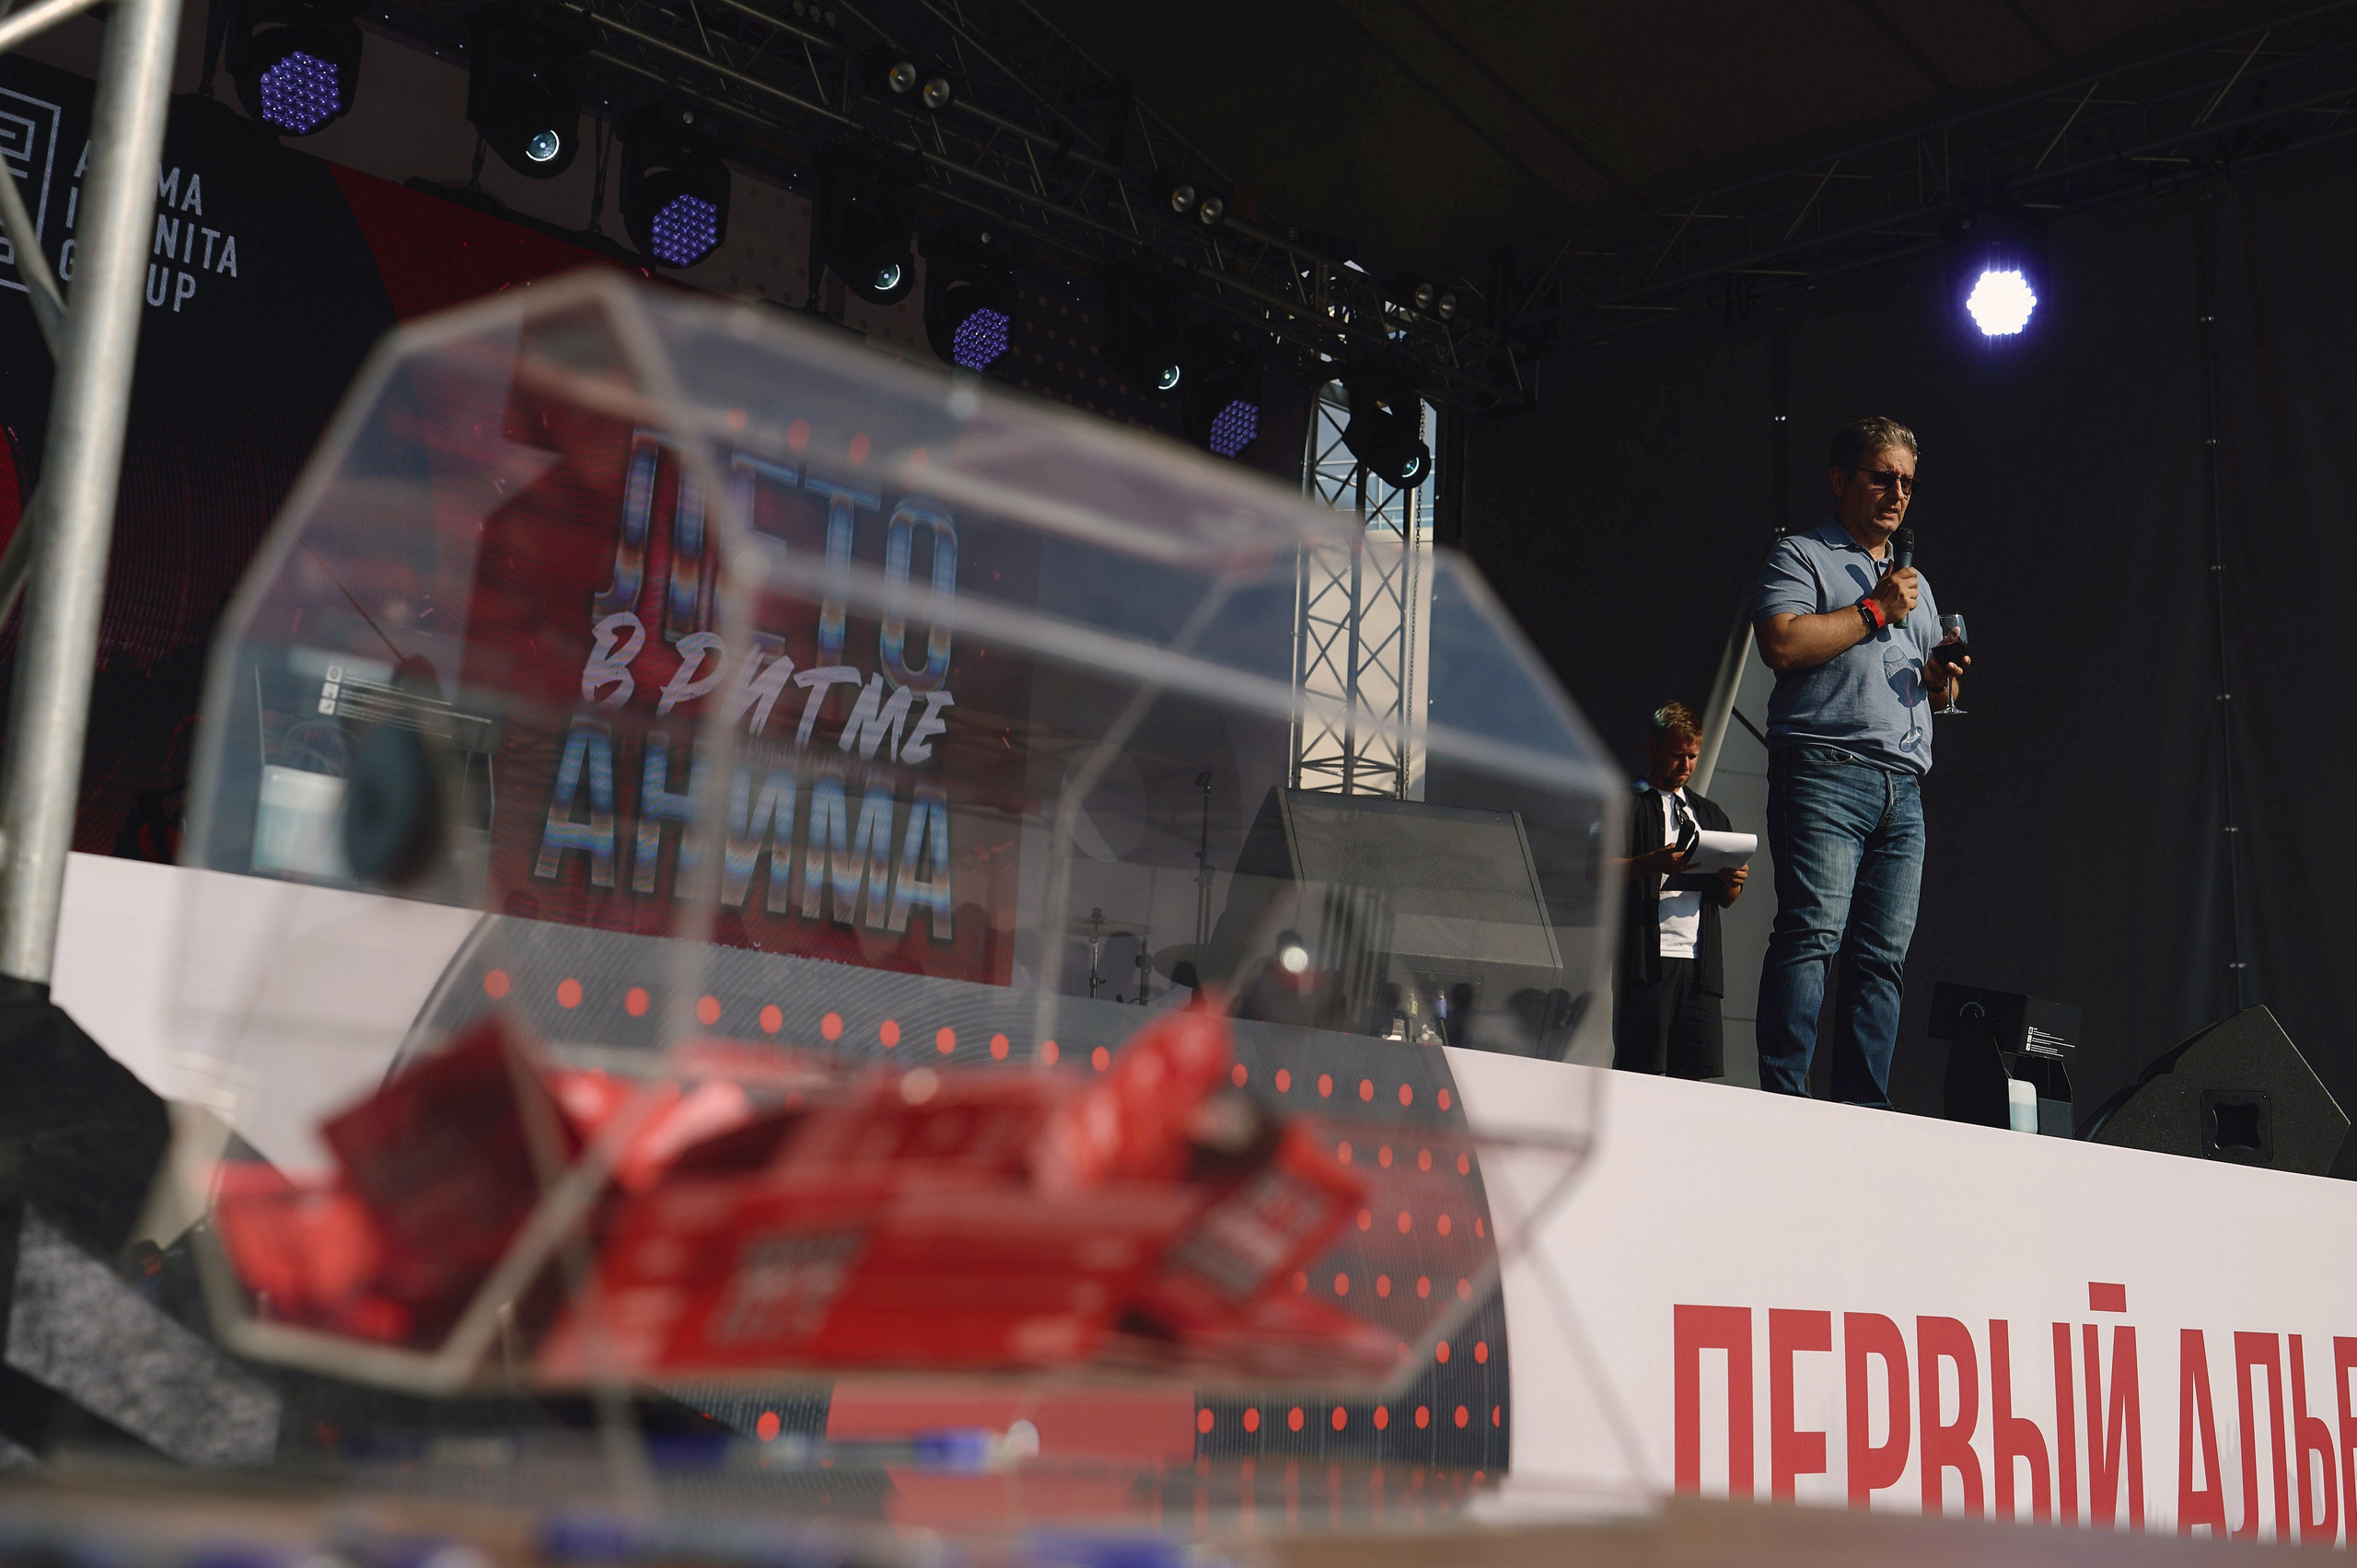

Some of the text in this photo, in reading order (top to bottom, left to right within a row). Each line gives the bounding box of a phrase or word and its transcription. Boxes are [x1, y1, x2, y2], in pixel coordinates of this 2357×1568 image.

[59, 238, 196, 312] GUP
[65, 187, 238, 277] INITA
[592, 427, 958, 700] ЛЕТО
[582, 612, 645, 710] В
[656, 632, 955, 765] РИТМЕ
[534, 716, 953, 940] АНИМА
[1673, 1282, 2145, 1536] ПЕРВЫЙ
